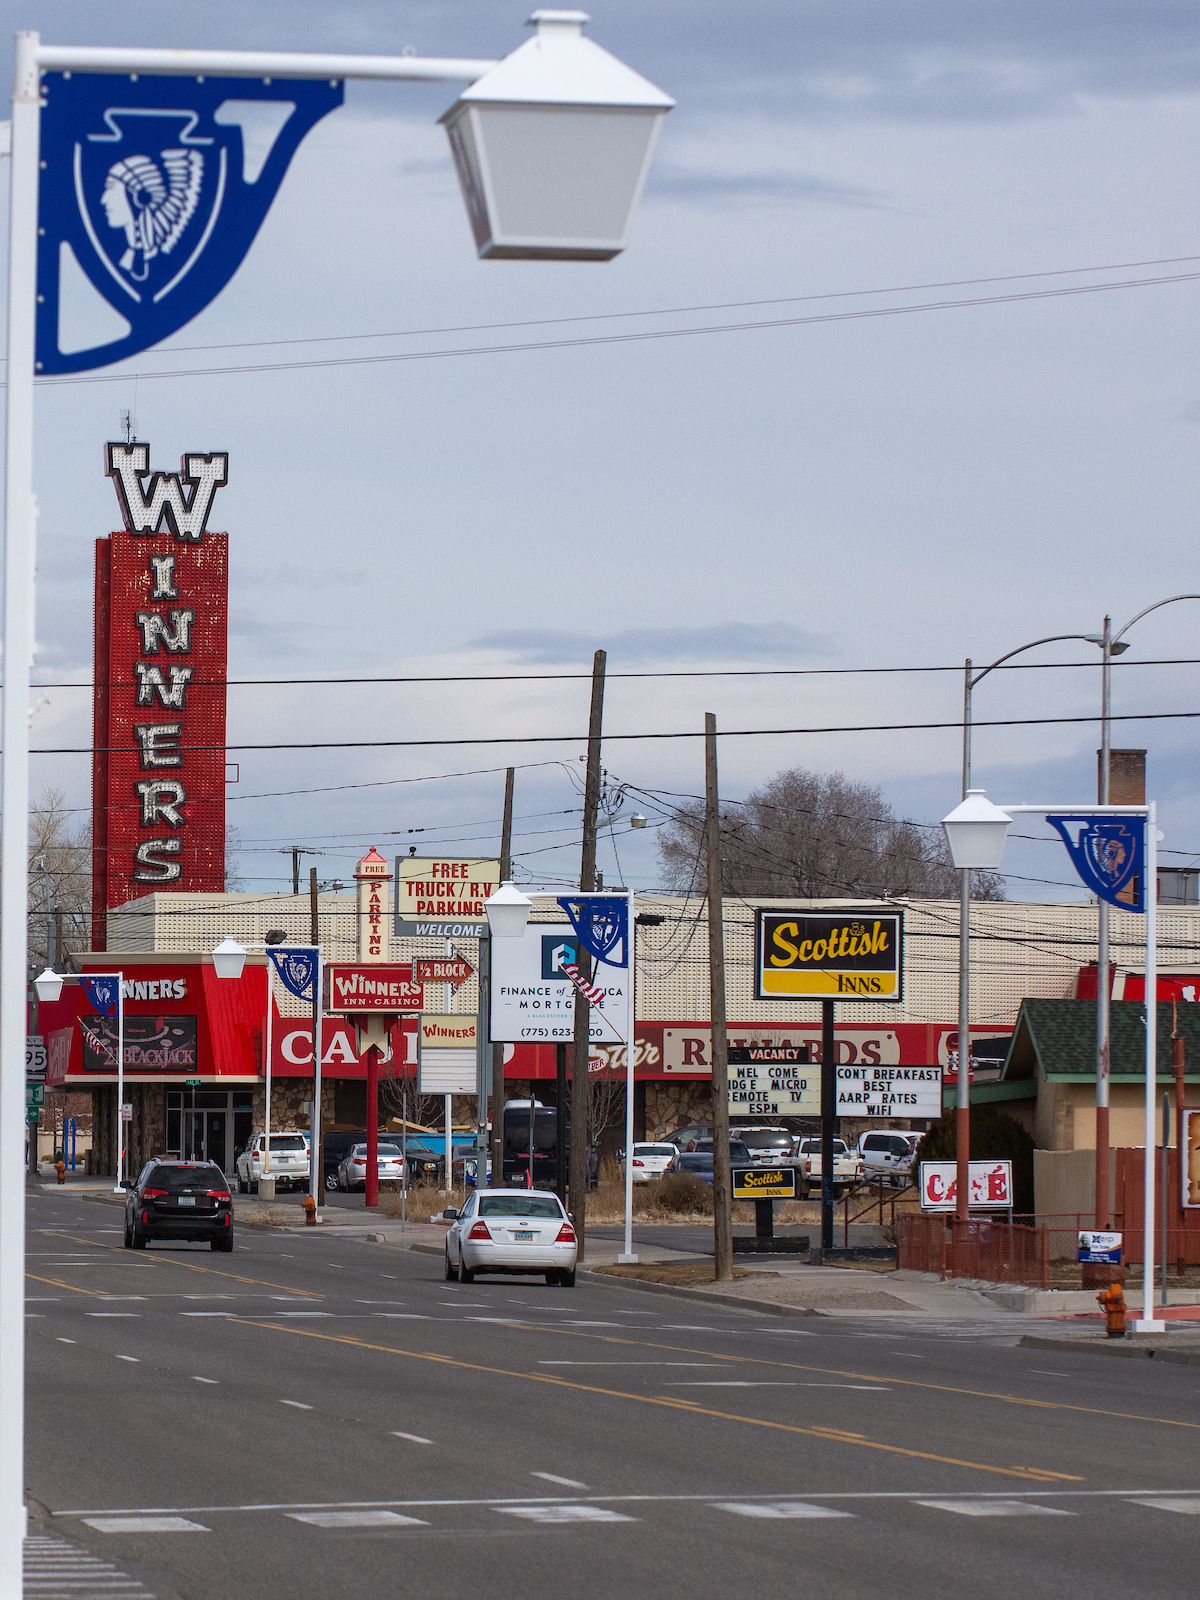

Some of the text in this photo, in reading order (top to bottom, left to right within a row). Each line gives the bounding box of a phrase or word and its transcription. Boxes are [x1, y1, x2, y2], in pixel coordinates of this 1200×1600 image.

[104, 442, 228, 883] WINNERS
[432, 863, 469, 878] FREE
[406, 882, 455, 897] TRUCK
[417, 901, 483, 917] PARKING
[368, 883, 382, 955] PARKING
[416, 924, 483, 937] WELCOME
[769, 920, 889, 967] Scottish
[434, 964, 467, 977] BLOCK
[123, 979, 187, 1000] NNERS
[336, 973, 421, 997] WINNERS
[838, 974, 881, 993] INNS
[500, 987, 551, 996] FINANCE
[556, 986, 567, 996] of
[423, 1024, 476, 1038] WINNERS
[520, 1027, 603, 1037] (775) 623-00
[26, 1051, 45, 1066] 95
[750, 1049, 800, 1060] VACANCY
[837, 1068, 940, 1080] CONT BREAKFAST
[771, 1079, 807, 1090] MICRO
[863, 1081, 892, 1091] BEST
[790, 1091, 802, 1102] TV
[838, 1092, 917, 1104] AARP RATES
[749, 1103, 779, 1113] ESPN
[866, 1104, 892, 1116] WIFI
[743, 1170, 784, 1188] Scottish
